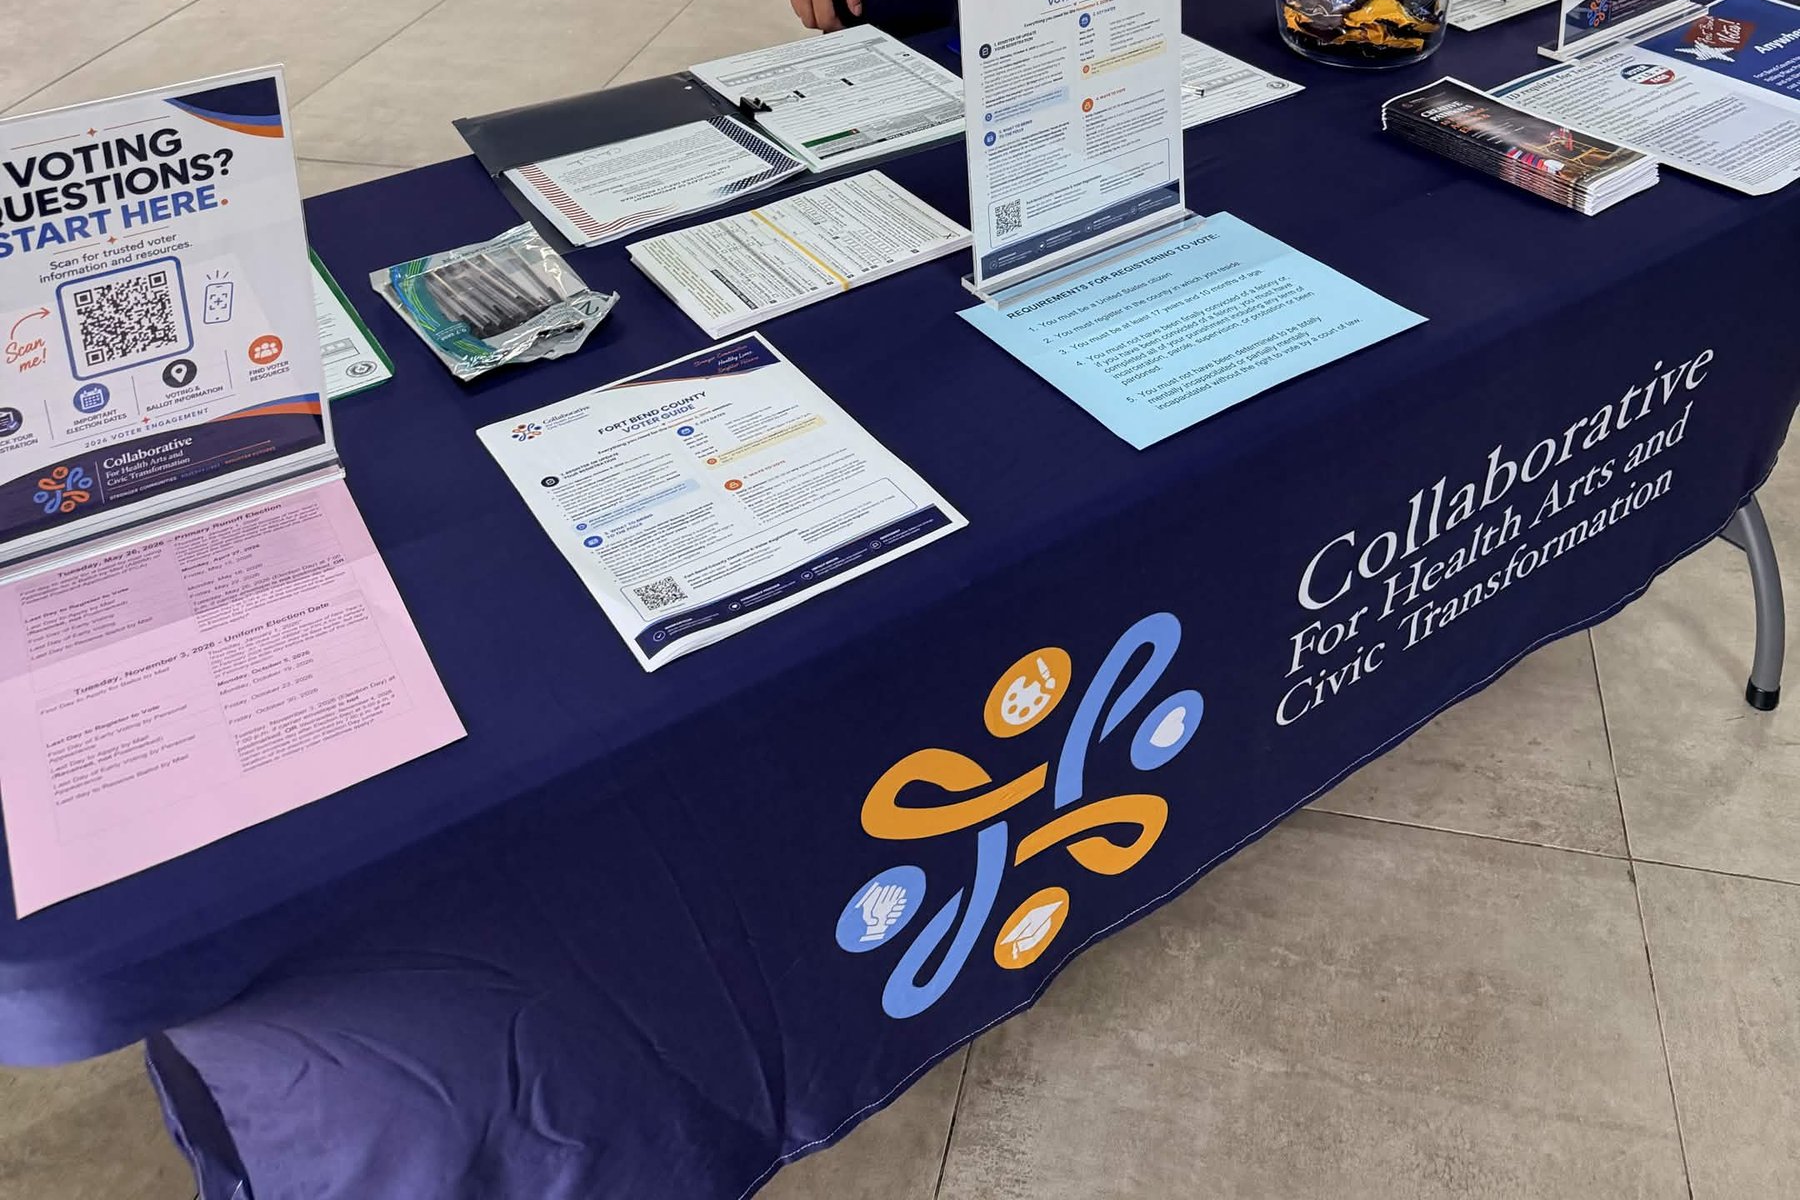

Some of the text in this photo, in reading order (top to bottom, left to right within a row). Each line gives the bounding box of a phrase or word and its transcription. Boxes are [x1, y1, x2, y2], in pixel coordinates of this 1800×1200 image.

[3, 128, 182, 188] VOTING
[121, 184, 229, 229] HERE.
[39, 241, 193, 283] information and resources.
[50, 233, 177, 270] Scan for trusted voter
[1007, 284, 1088, 318] REQUIREMENTS
[1088, 275, 1111, 286] FOR
[1110, 249, 1175, 276] REGISTERING
[1189, 233, 1220, 245] VOTE:
[1038, 318, 1057, 327] You
[1057, 310, 1078, 320] must
[1095, 291, 1122, 304] United
[1121, 282, 1147, 294] States
[1054, 329, 1073, 338] You
[1073, 320, 1094, 331] must
[1094, 308, 1123, 323] register
[1131, 299, 1146, 307] the
[1146, 289, 1172, 301] county
[1180, 276, 1203, 287] which
[1202, 270, 1217, 279] you
[1069, 341, 1089, 349] You
[1089, 331, 1110, 342] must
[1129, 314, 1151, 324] least
[1162, 301, 1184, 312] years
[1184, 294, 1200, 302] and
[1210, 278, 1239, 292] months
[1085, 352, 1105, 360] You
[1105, 342, 1127, 354] must
[1126, 336, 1141, 345] not
[1139, 328, 1161, 339] have
[1160, 319, 1182, 330] been
[1180, 310, 1205, 321] finally
[1204, 294, 1240, 311] convicted
[1254, 279, 1279, 290] felony
[6, 338, 45, 364] Scan
[19, 347, 47, 373] me!
[249, 360, 289, 376] FIND VOTER
[166, 387, 194, 399] VOTING
[250, 367, 290, 382] RESOURCES
[146, 385, 224, 412] BALLOT INFORMATION
[598, 420, 626, 434] FORT
[629, 409, 659, 423] BEND
[661, 391, 705, 411] COUNTY
[66, 413, 128, 435] ELECTION DATES
[73, 409, 118, 426] IMPORTANT
[112, 427, 142, 441] VOTER
[146, 407, 210, 431] ENGAGEMENT
[622, 403, 694, 432] VOTER GUIDE
[13, 433, 34, 443] YOUR
[103, 436, 193, 469] Collaborative
[105, 450, 184, 479] For Health Arts and
[107, 475, 127, 487] Civic
[129, 456, 191, 481] Transformation
[1297, 347, 1714, 611] Collaborative
[58, 562, 101, 577] Tuesday,
[104, 554, 123, 563] May
[143, 541, 164, 551] 2026
[174, 527, 209, 540] Primary
[212, 515, 242, 528] Runoff
[245, 504, 281, 518] Election
[1284, 401, 1694, 679] For Health Arts and
[1275, 468, 1674, 727] Civic Transformation
[74, 676, 121, 694] Tuesday,
[125, 655, 176, 677] November
[224, 625, 263, 642] Uniform
[266, 611, 305, 627] Election
[307, 602, 328, 612] Date
